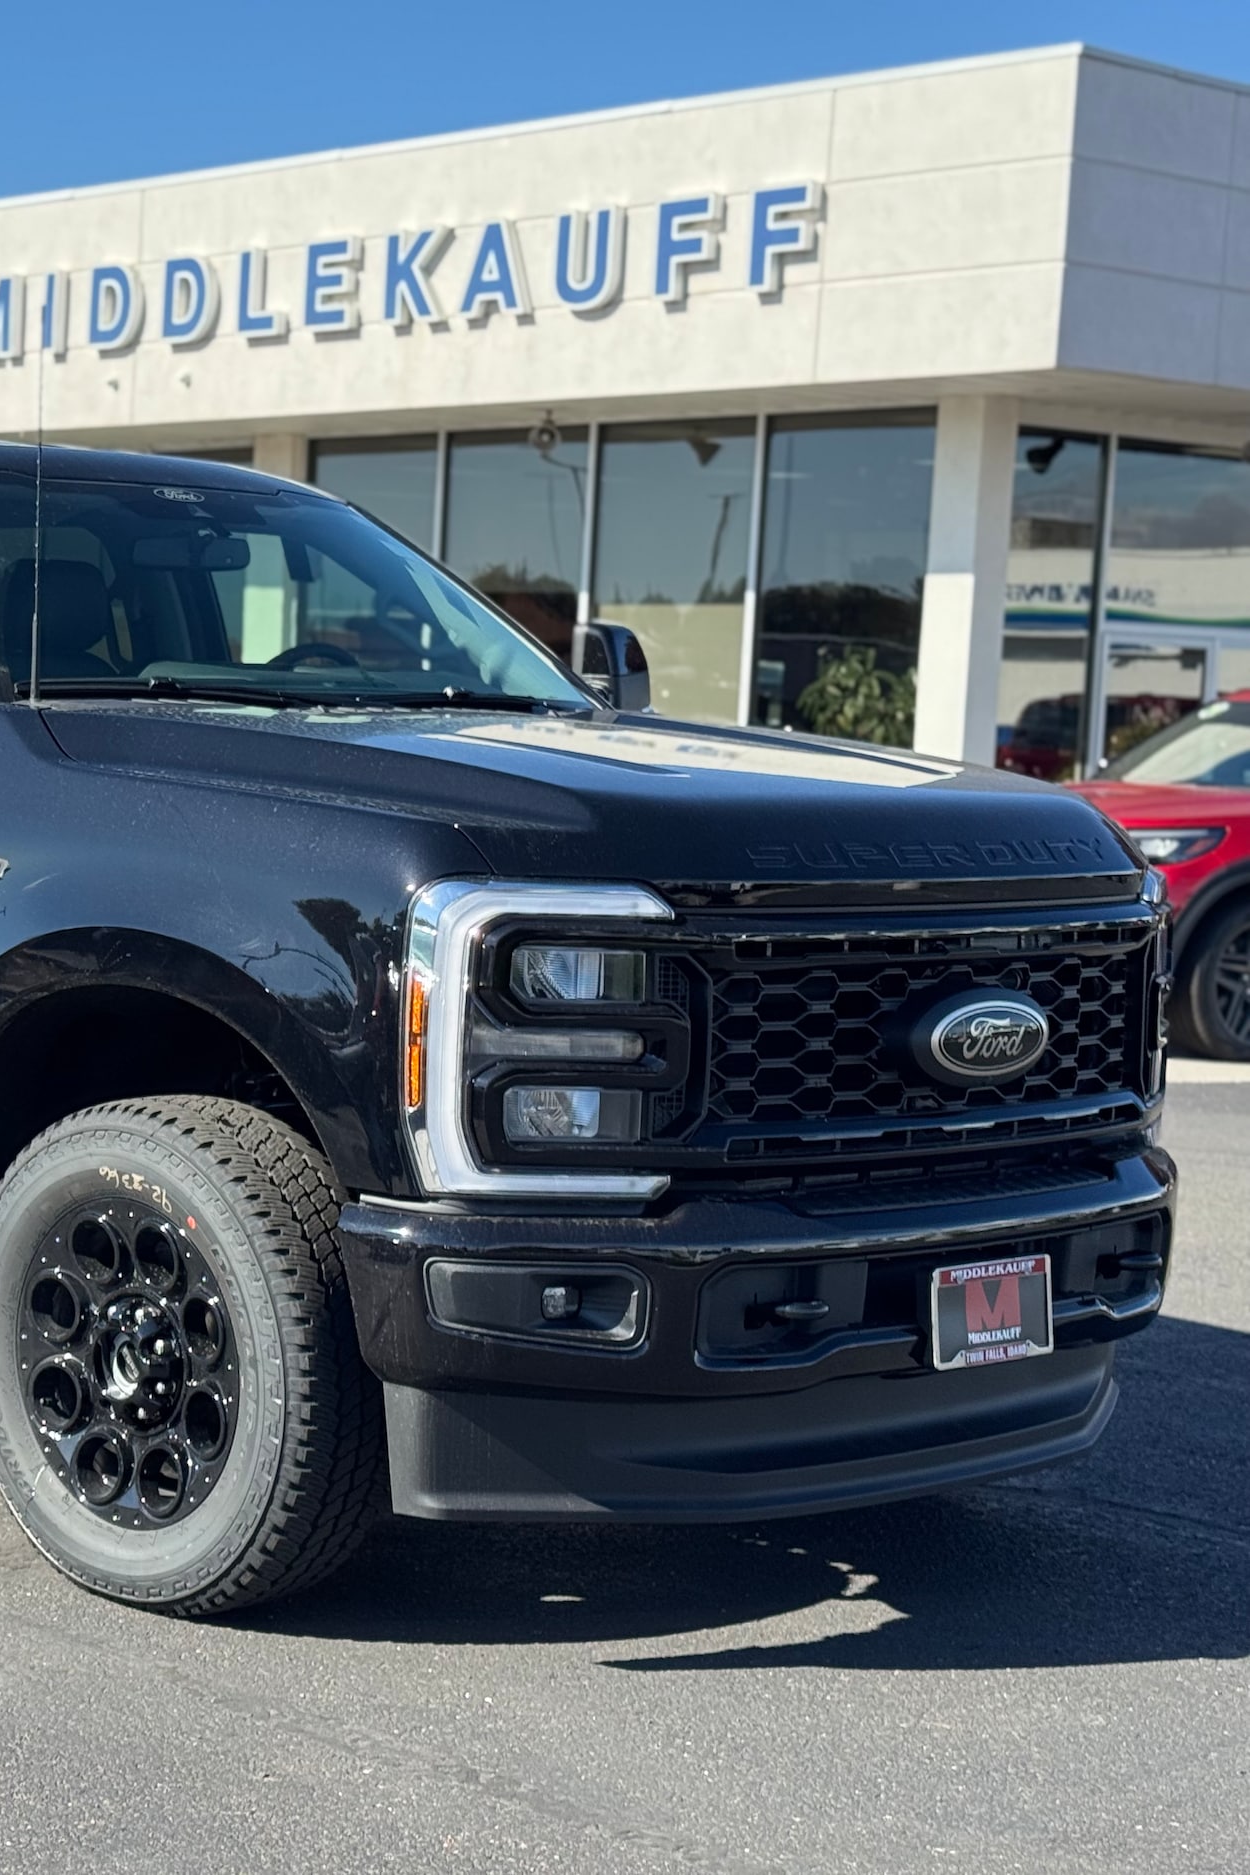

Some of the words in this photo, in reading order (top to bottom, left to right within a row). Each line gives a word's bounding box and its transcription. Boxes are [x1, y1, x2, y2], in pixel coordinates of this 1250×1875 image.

[745, 842, 975, 869] SUPER
[975, 837, 1103, 867] DUTY
[962, 1016, 1026, 1060] Ford
[950, 1260, 1036, 1281] MIDDLEKAUFF
[967, 1326, 1022, 1345] MIDDLEKAUFF
